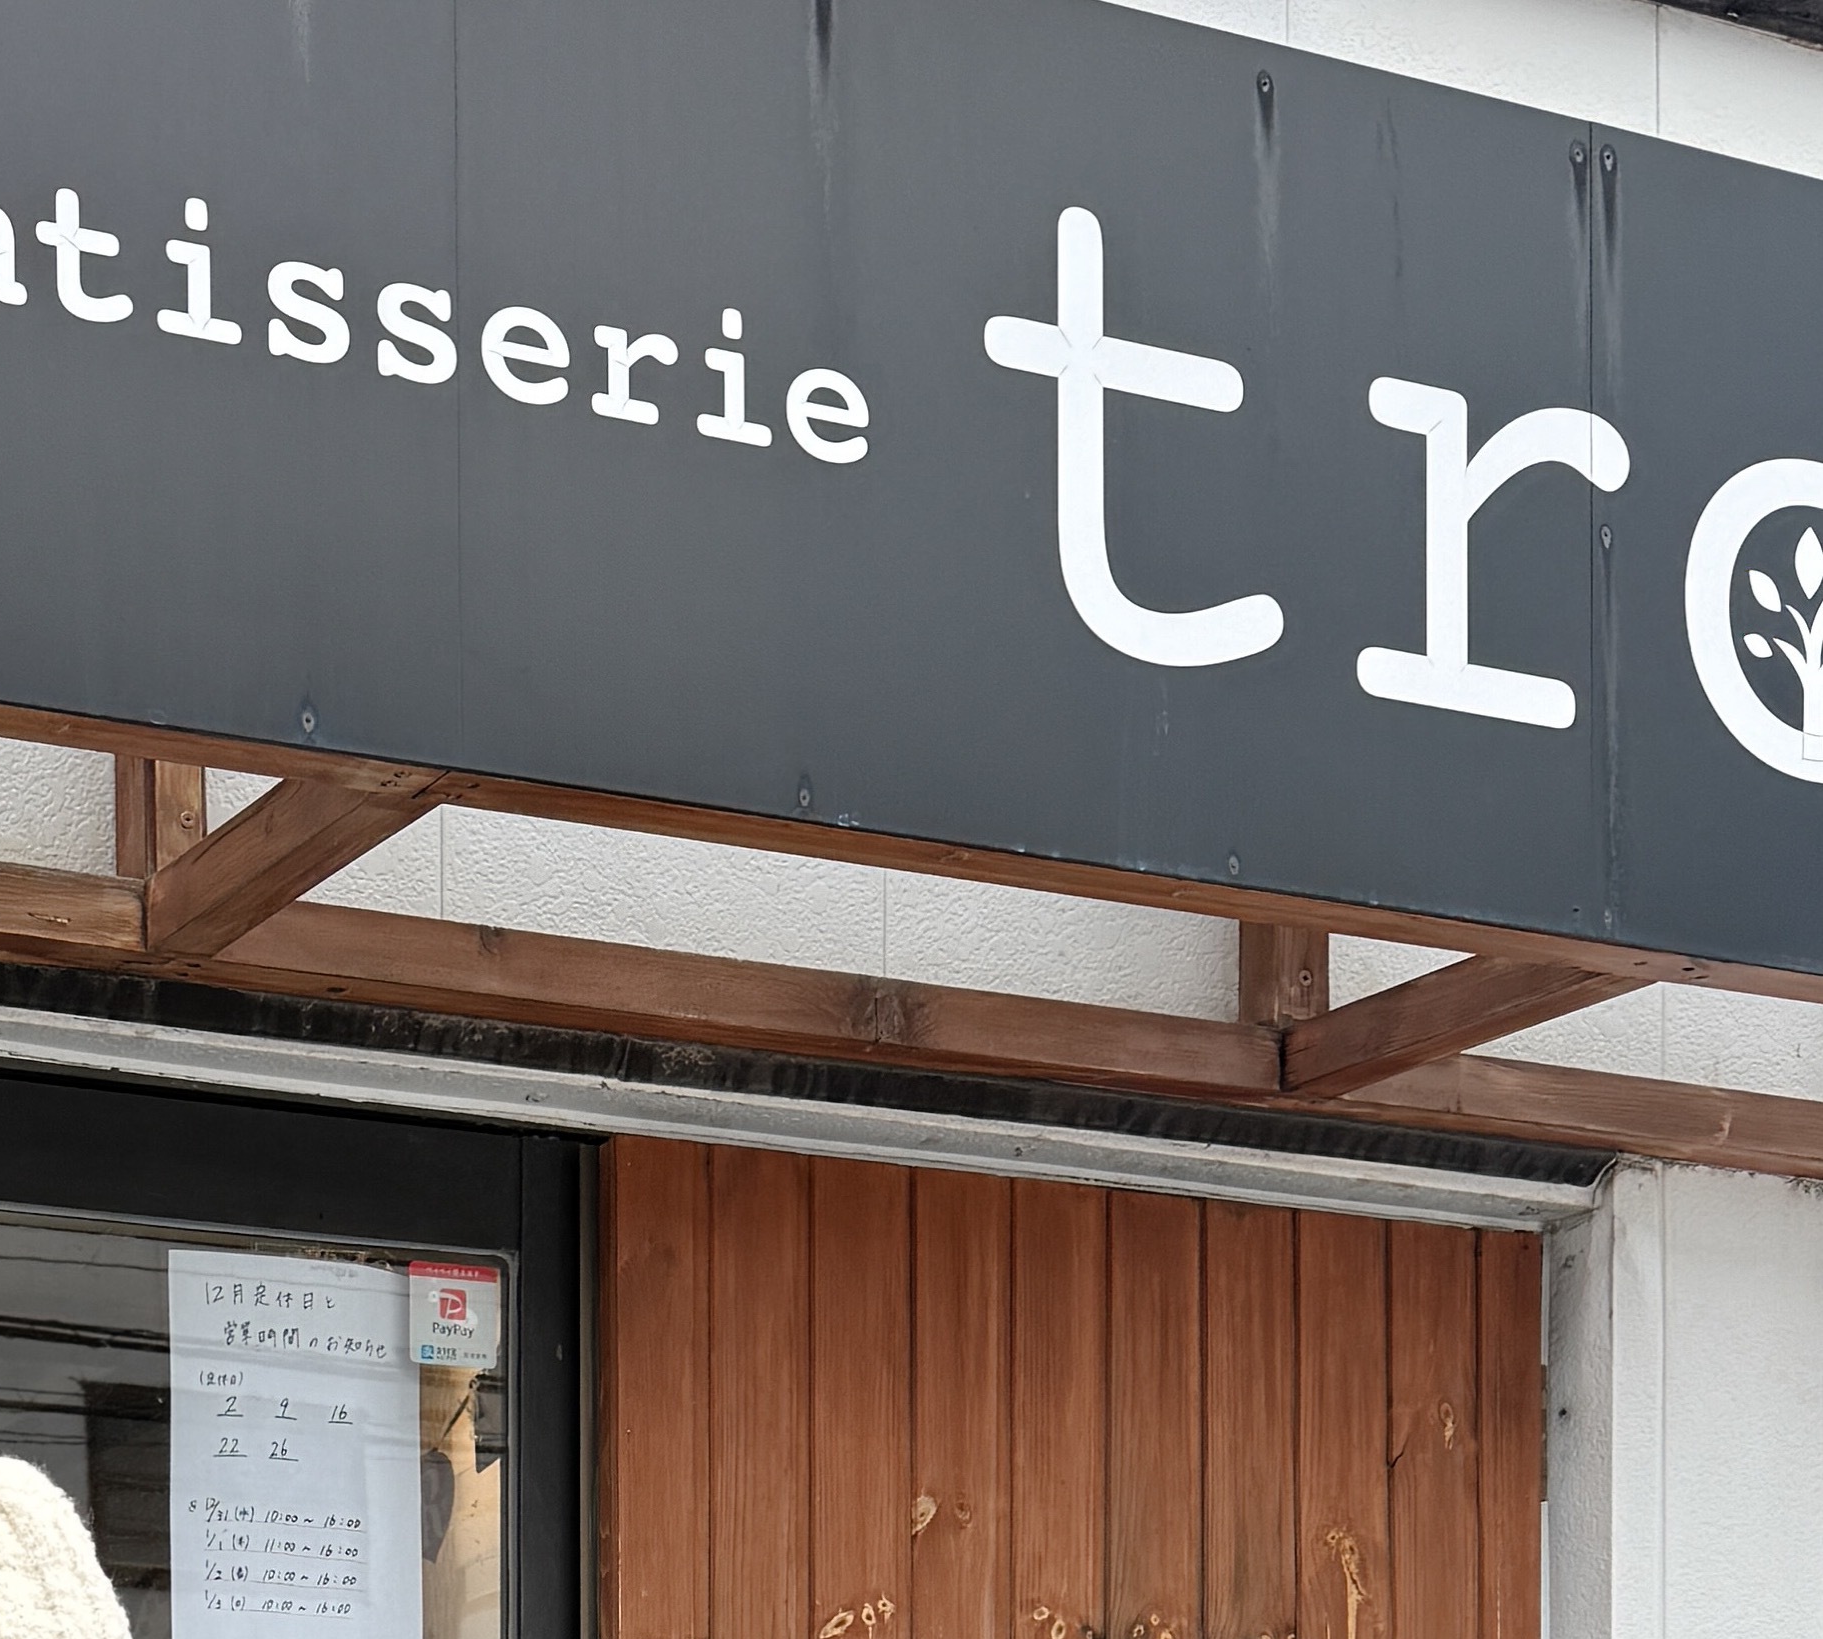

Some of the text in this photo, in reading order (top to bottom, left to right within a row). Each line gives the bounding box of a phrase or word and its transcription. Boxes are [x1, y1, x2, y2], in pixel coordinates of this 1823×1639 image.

[205, 1281, 336, 1310] 12月定休日と
[432, 1322, 475, 1338] PayPay
[225, 1396, 347, 1421] 2 9 16
[218, 1438, 288, 1457] 22 26
